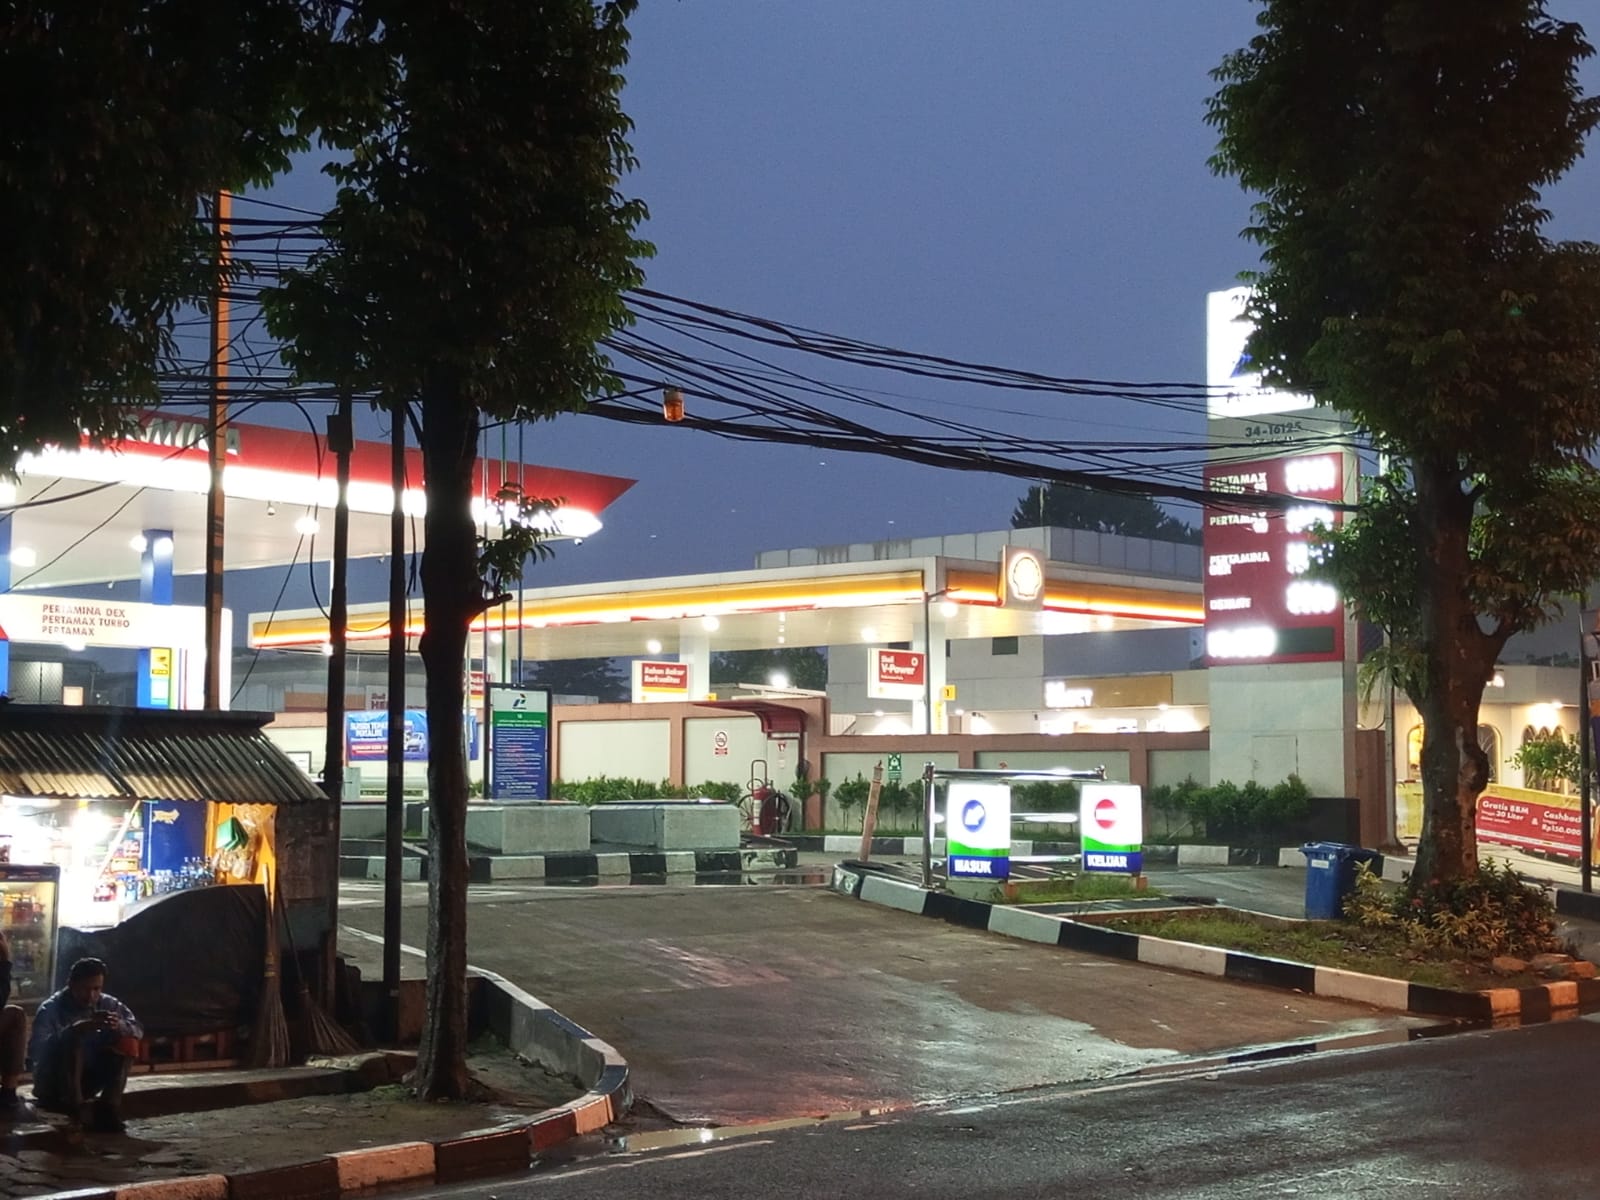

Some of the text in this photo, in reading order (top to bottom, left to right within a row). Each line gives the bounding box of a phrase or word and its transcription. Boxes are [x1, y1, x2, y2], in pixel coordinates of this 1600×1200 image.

[42, 614, 96, 627] PERTAMAX
[1482, 800, 1508, 812] Gratis
[1507, 812, 1524, 821] Liter
[1087, 854, 1128, 868] KELUAR
